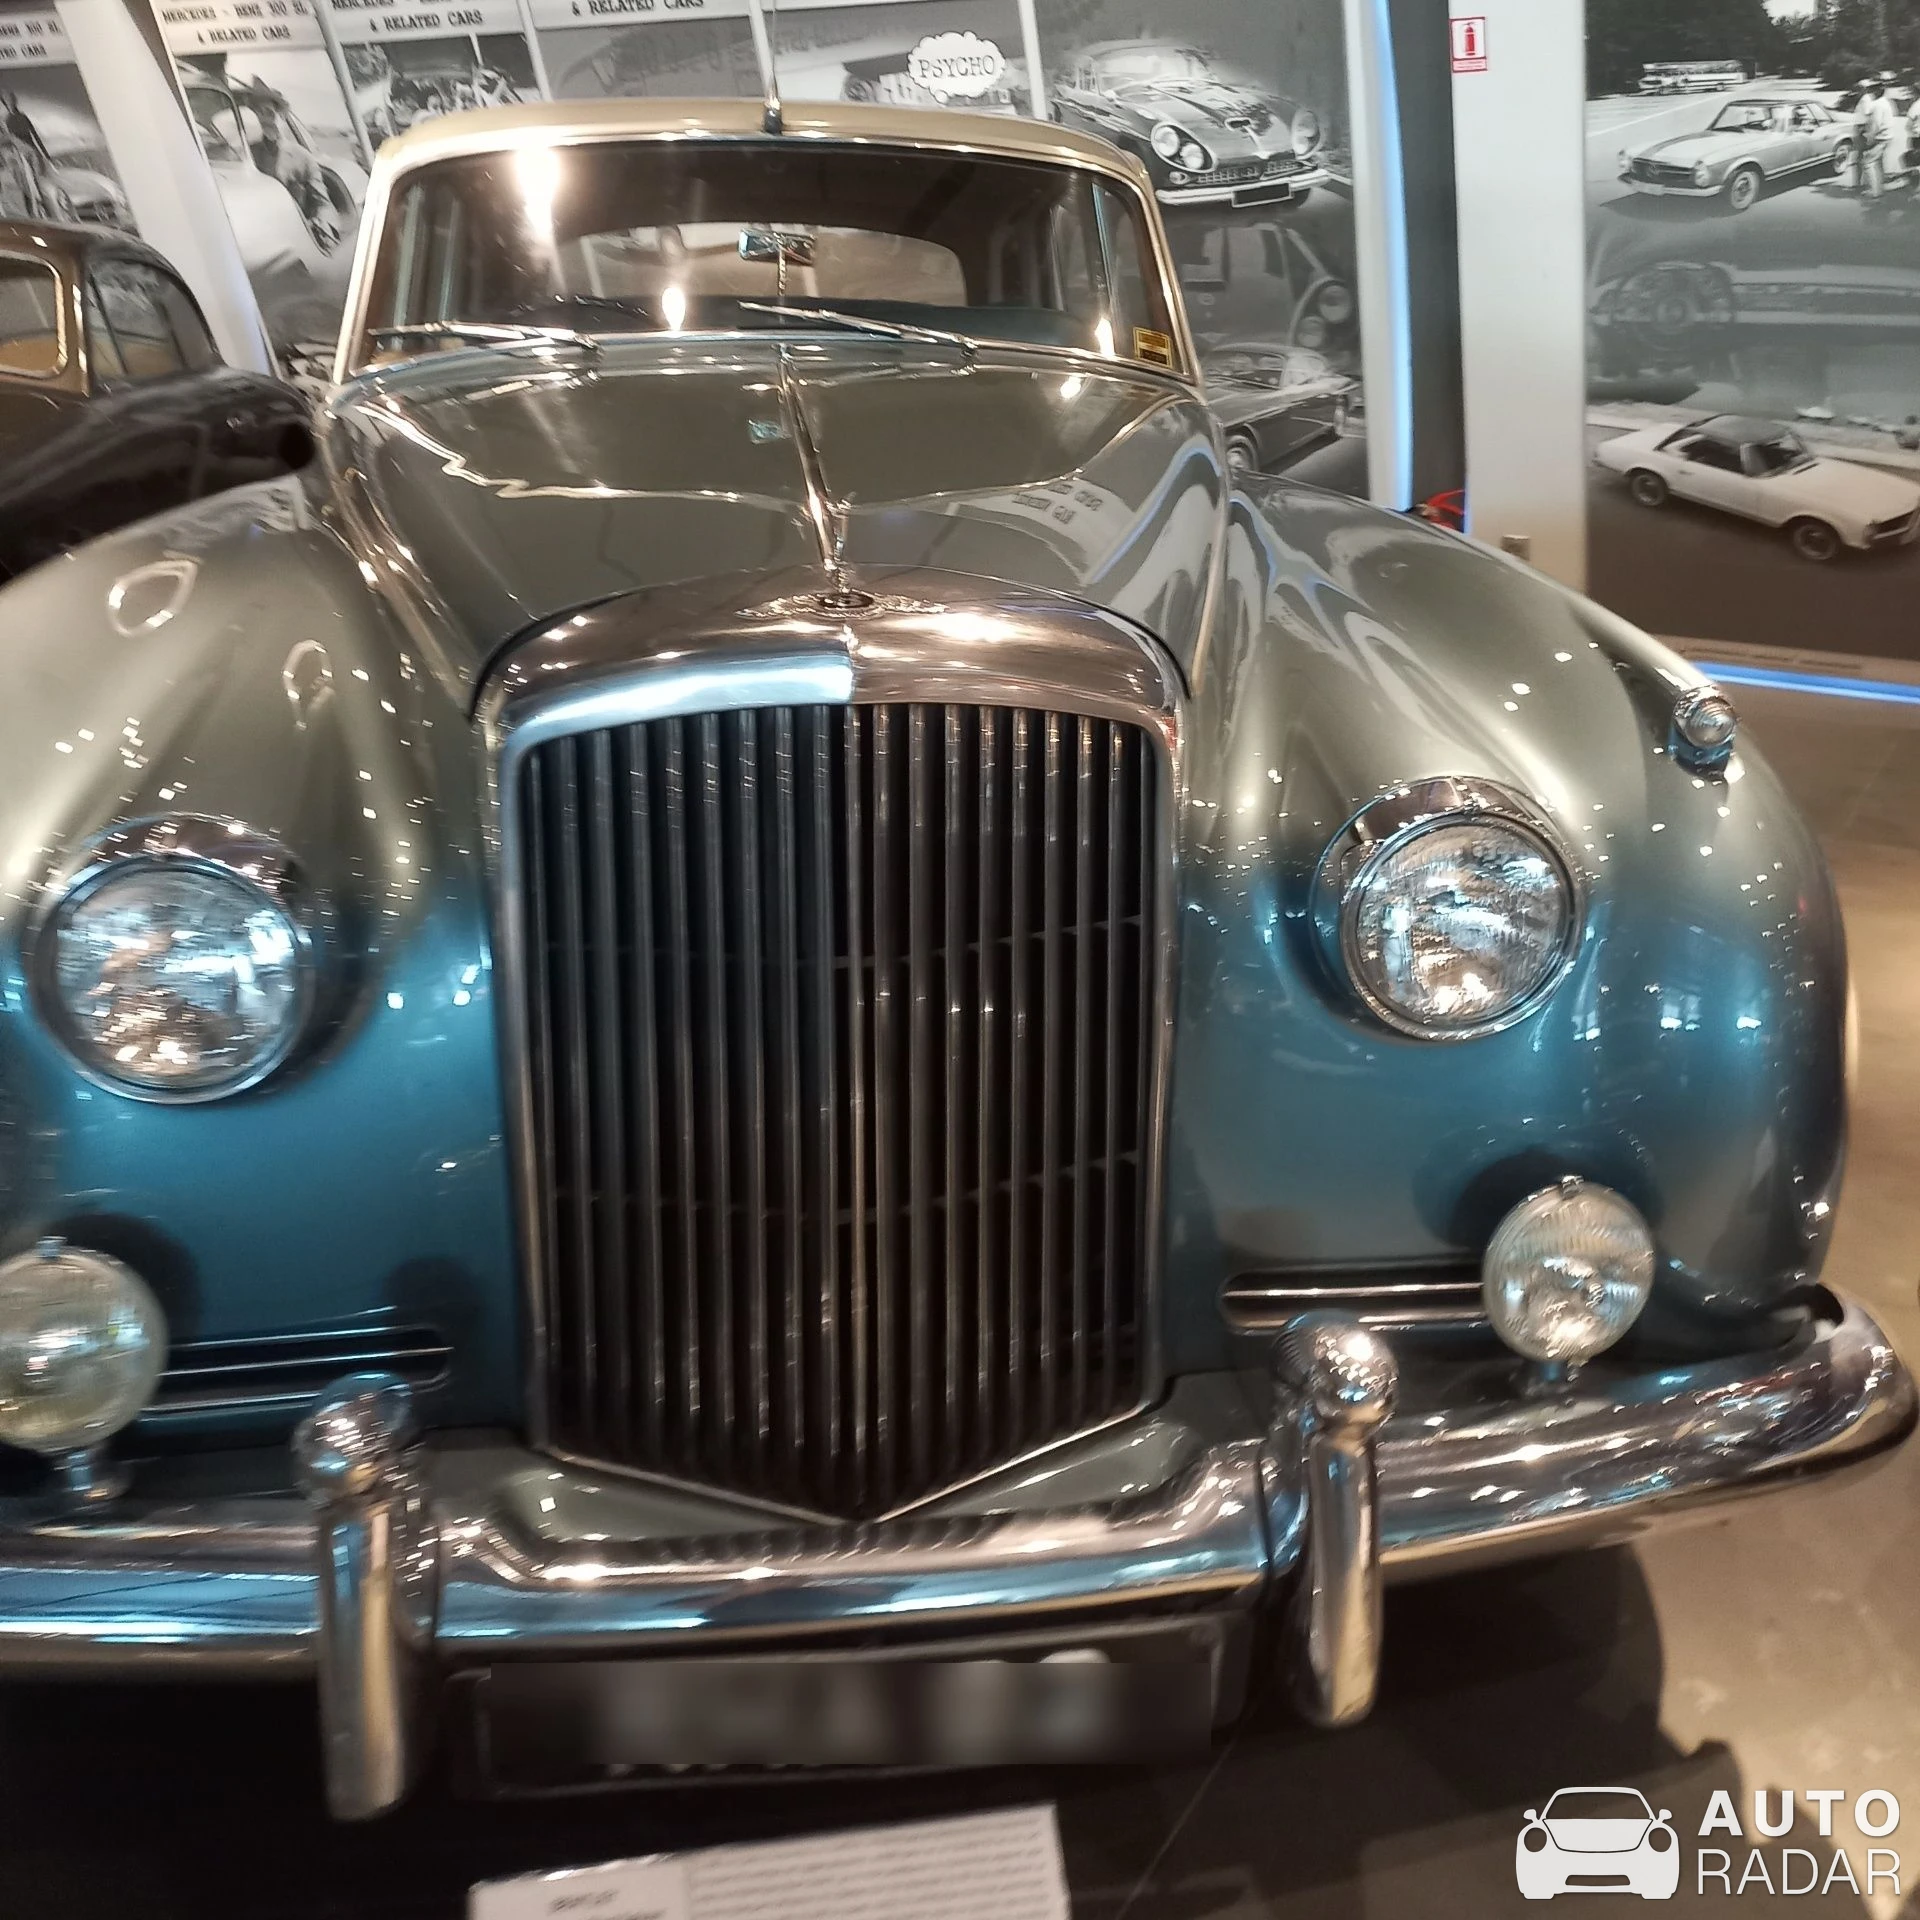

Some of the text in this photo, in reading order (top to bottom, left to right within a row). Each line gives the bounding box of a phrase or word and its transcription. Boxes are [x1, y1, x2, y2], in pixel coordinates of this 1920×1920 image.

[161, 6, 217, 24] MERCEDES
[383, 14, 440, 31] RELATED
[447, 9, 483, 26] CARS
[208, 26, 258, 43] RELATED
[261, 24, 291, 40] CARS
[919, 55, 994, 78] PSYCHO
